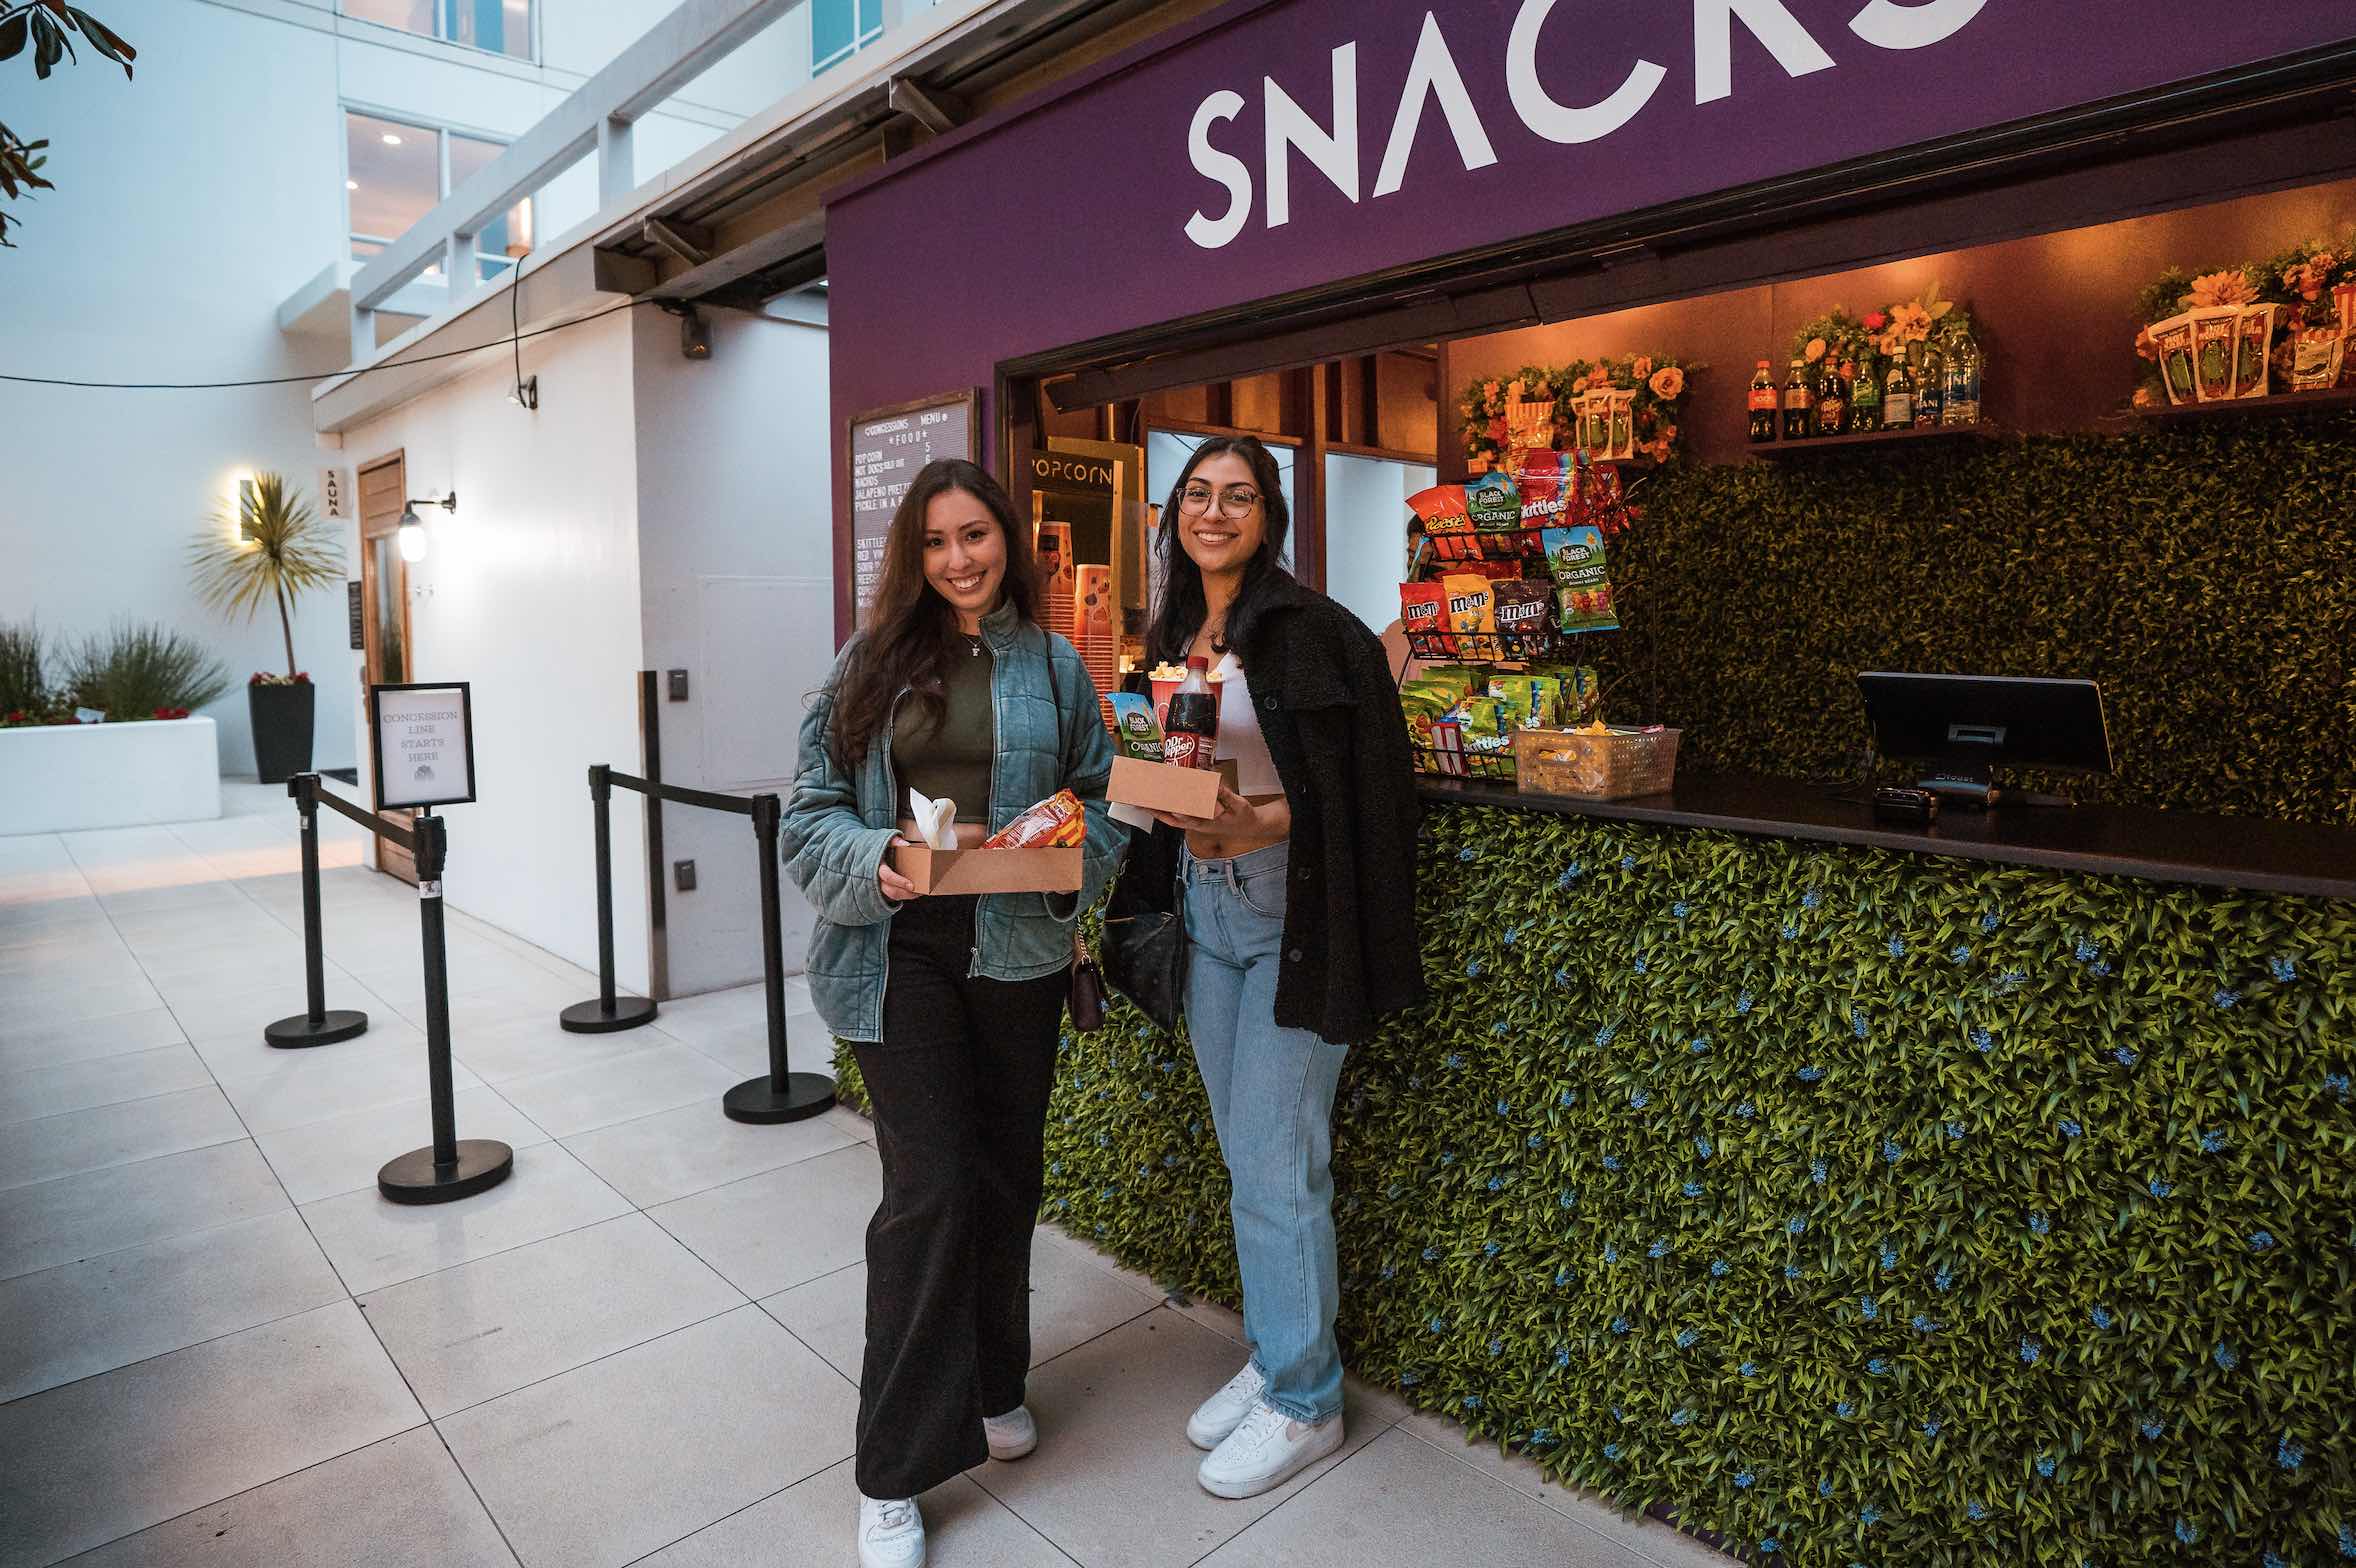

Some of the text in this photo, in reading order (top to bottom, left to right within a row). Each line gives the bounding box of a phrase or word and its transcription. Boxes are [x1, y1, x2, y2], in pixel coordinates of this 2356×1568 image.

[1184, 0, 1991, 249] SNACK
[920, 412, 941, 427] MENU
[925, 441, 931, 452] 5
[327, 469, 339, 516] SAUNA
[1471, 511, 1516, 522] ORGANIC
[1561, 547, 1588, 556] BLACK
[1561, 551, 1590, 562] FOREST
[1558, 565, 1606, 580] ORGANIC
[383, 711, 458, 724] CONCESSION
[408, 725, 435, 735] LINE
[401, 738, 445, 750] STARTS
[1172, 736, 1184, 747] Dr
[408, 751, 439, 763] HERE
